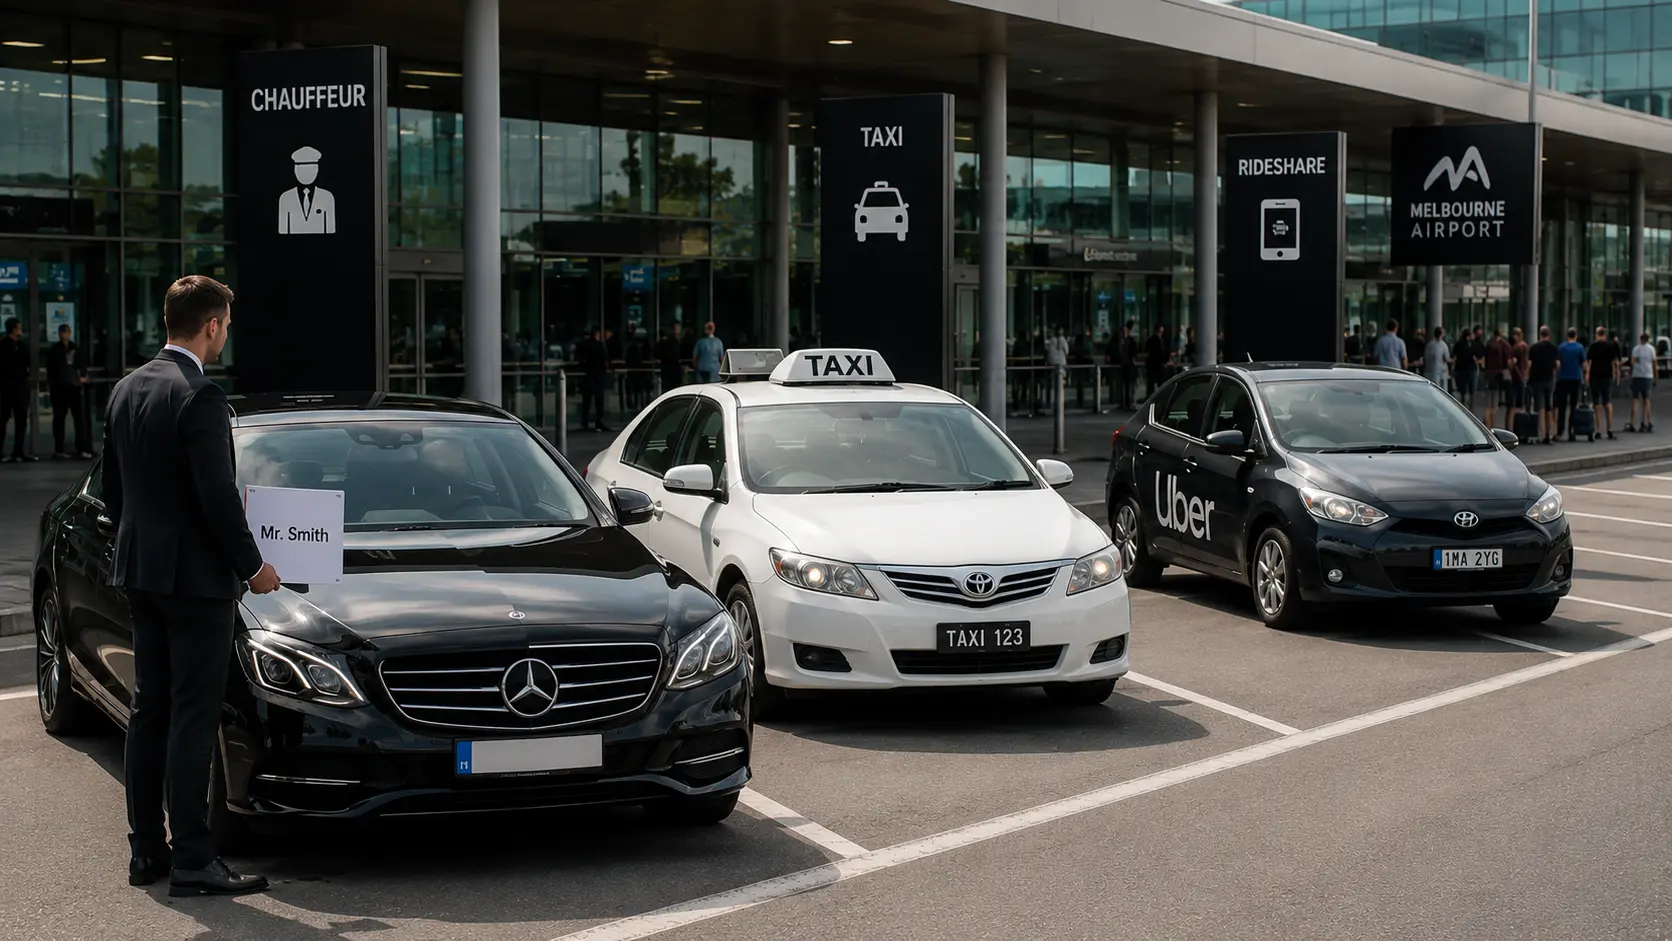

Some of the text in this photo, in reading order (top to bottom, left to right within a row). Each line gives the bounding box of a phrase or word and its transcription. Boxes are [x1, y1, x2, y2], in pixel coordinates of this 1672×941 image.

[251, 83, 366, 112] CHAUFFEUR
[860, 125, 903, 147] TAXI
[1238, 156, 1326, 176] RIDESHARE
[1410, 200, 1505, 218] MELBOURNE
[1411, 220, 1505, 238] AIRPORT
[804, 355, 874, 377] TAXI
[1155, 470, 1215, 541] Uber
[260, 525, 329, 543] Mr. Smith
[1445, 550, 1499, 567] 1MA 2YG
[946, 628, 1023, 647] TAXI 123
